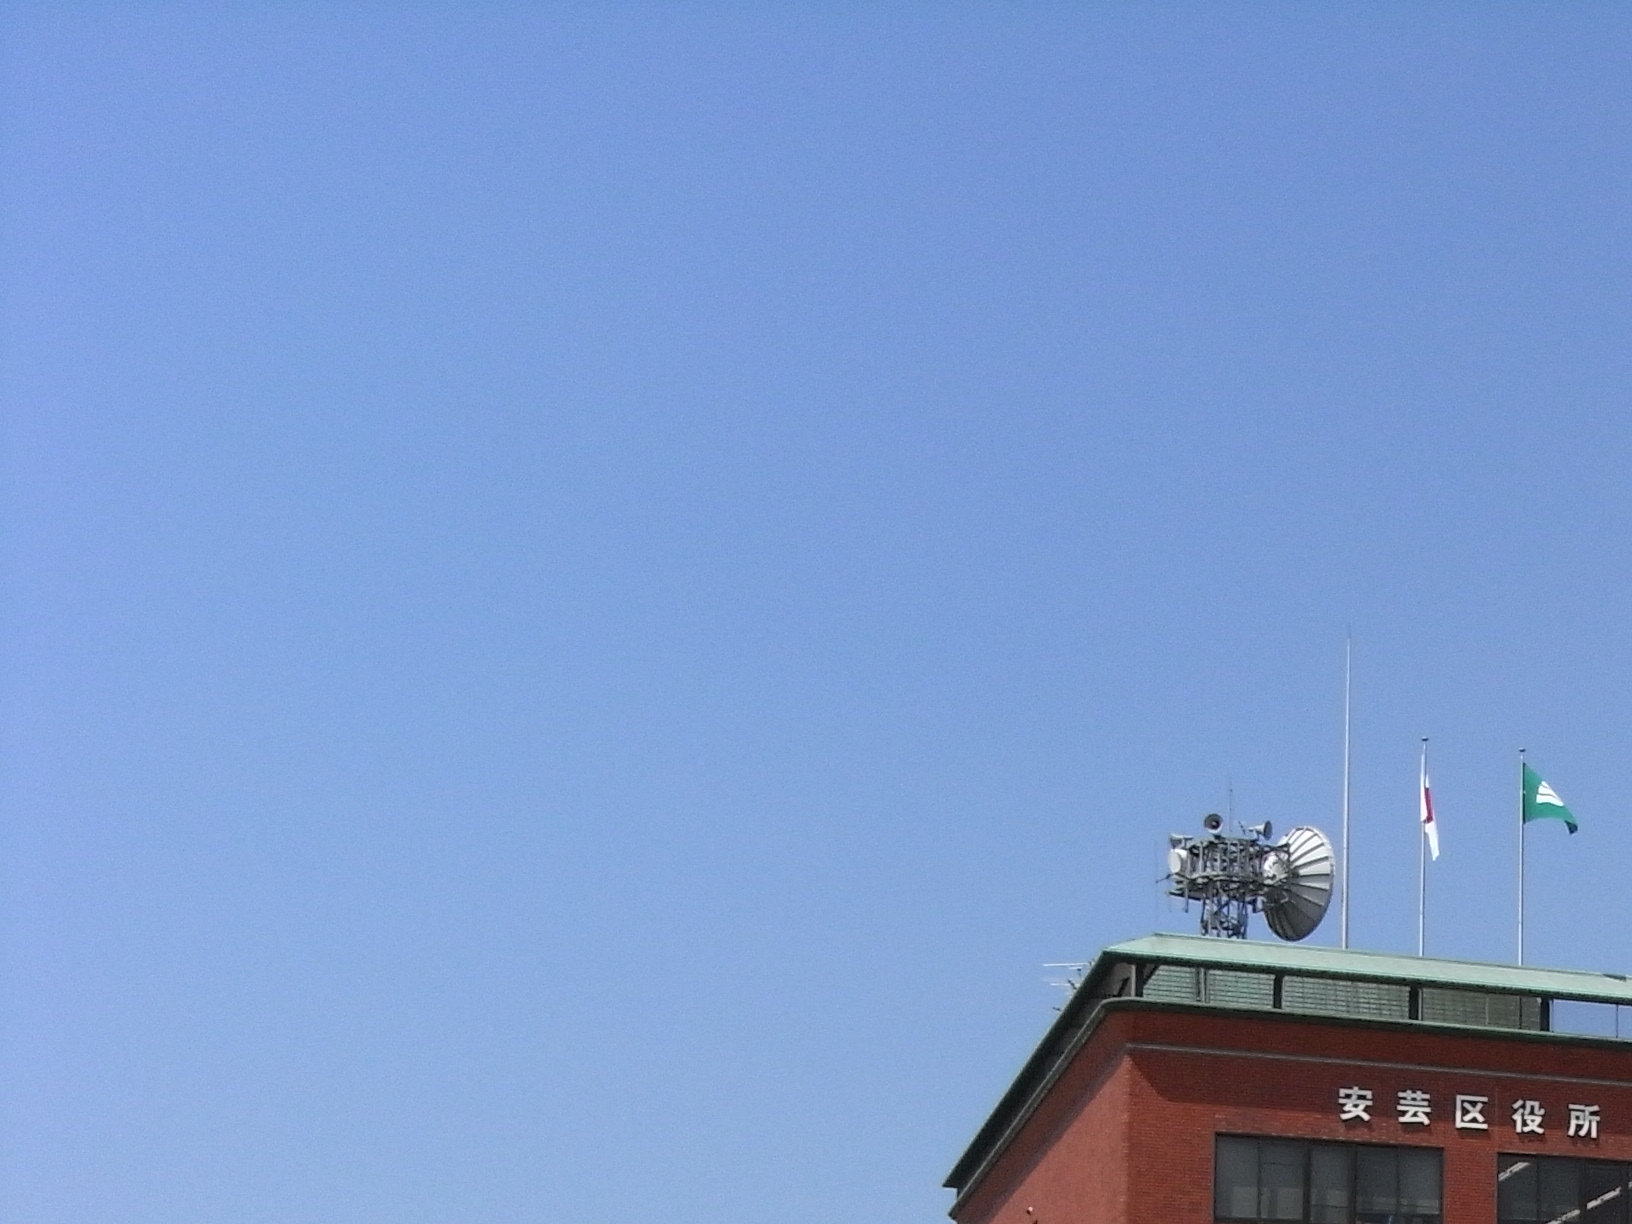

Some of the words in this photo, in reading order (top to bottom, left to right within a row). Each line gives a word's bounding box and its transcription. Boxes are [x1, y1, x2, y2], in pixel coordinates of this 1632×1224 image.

[1338, 1086, 1601, 1138] 安芸区役所
